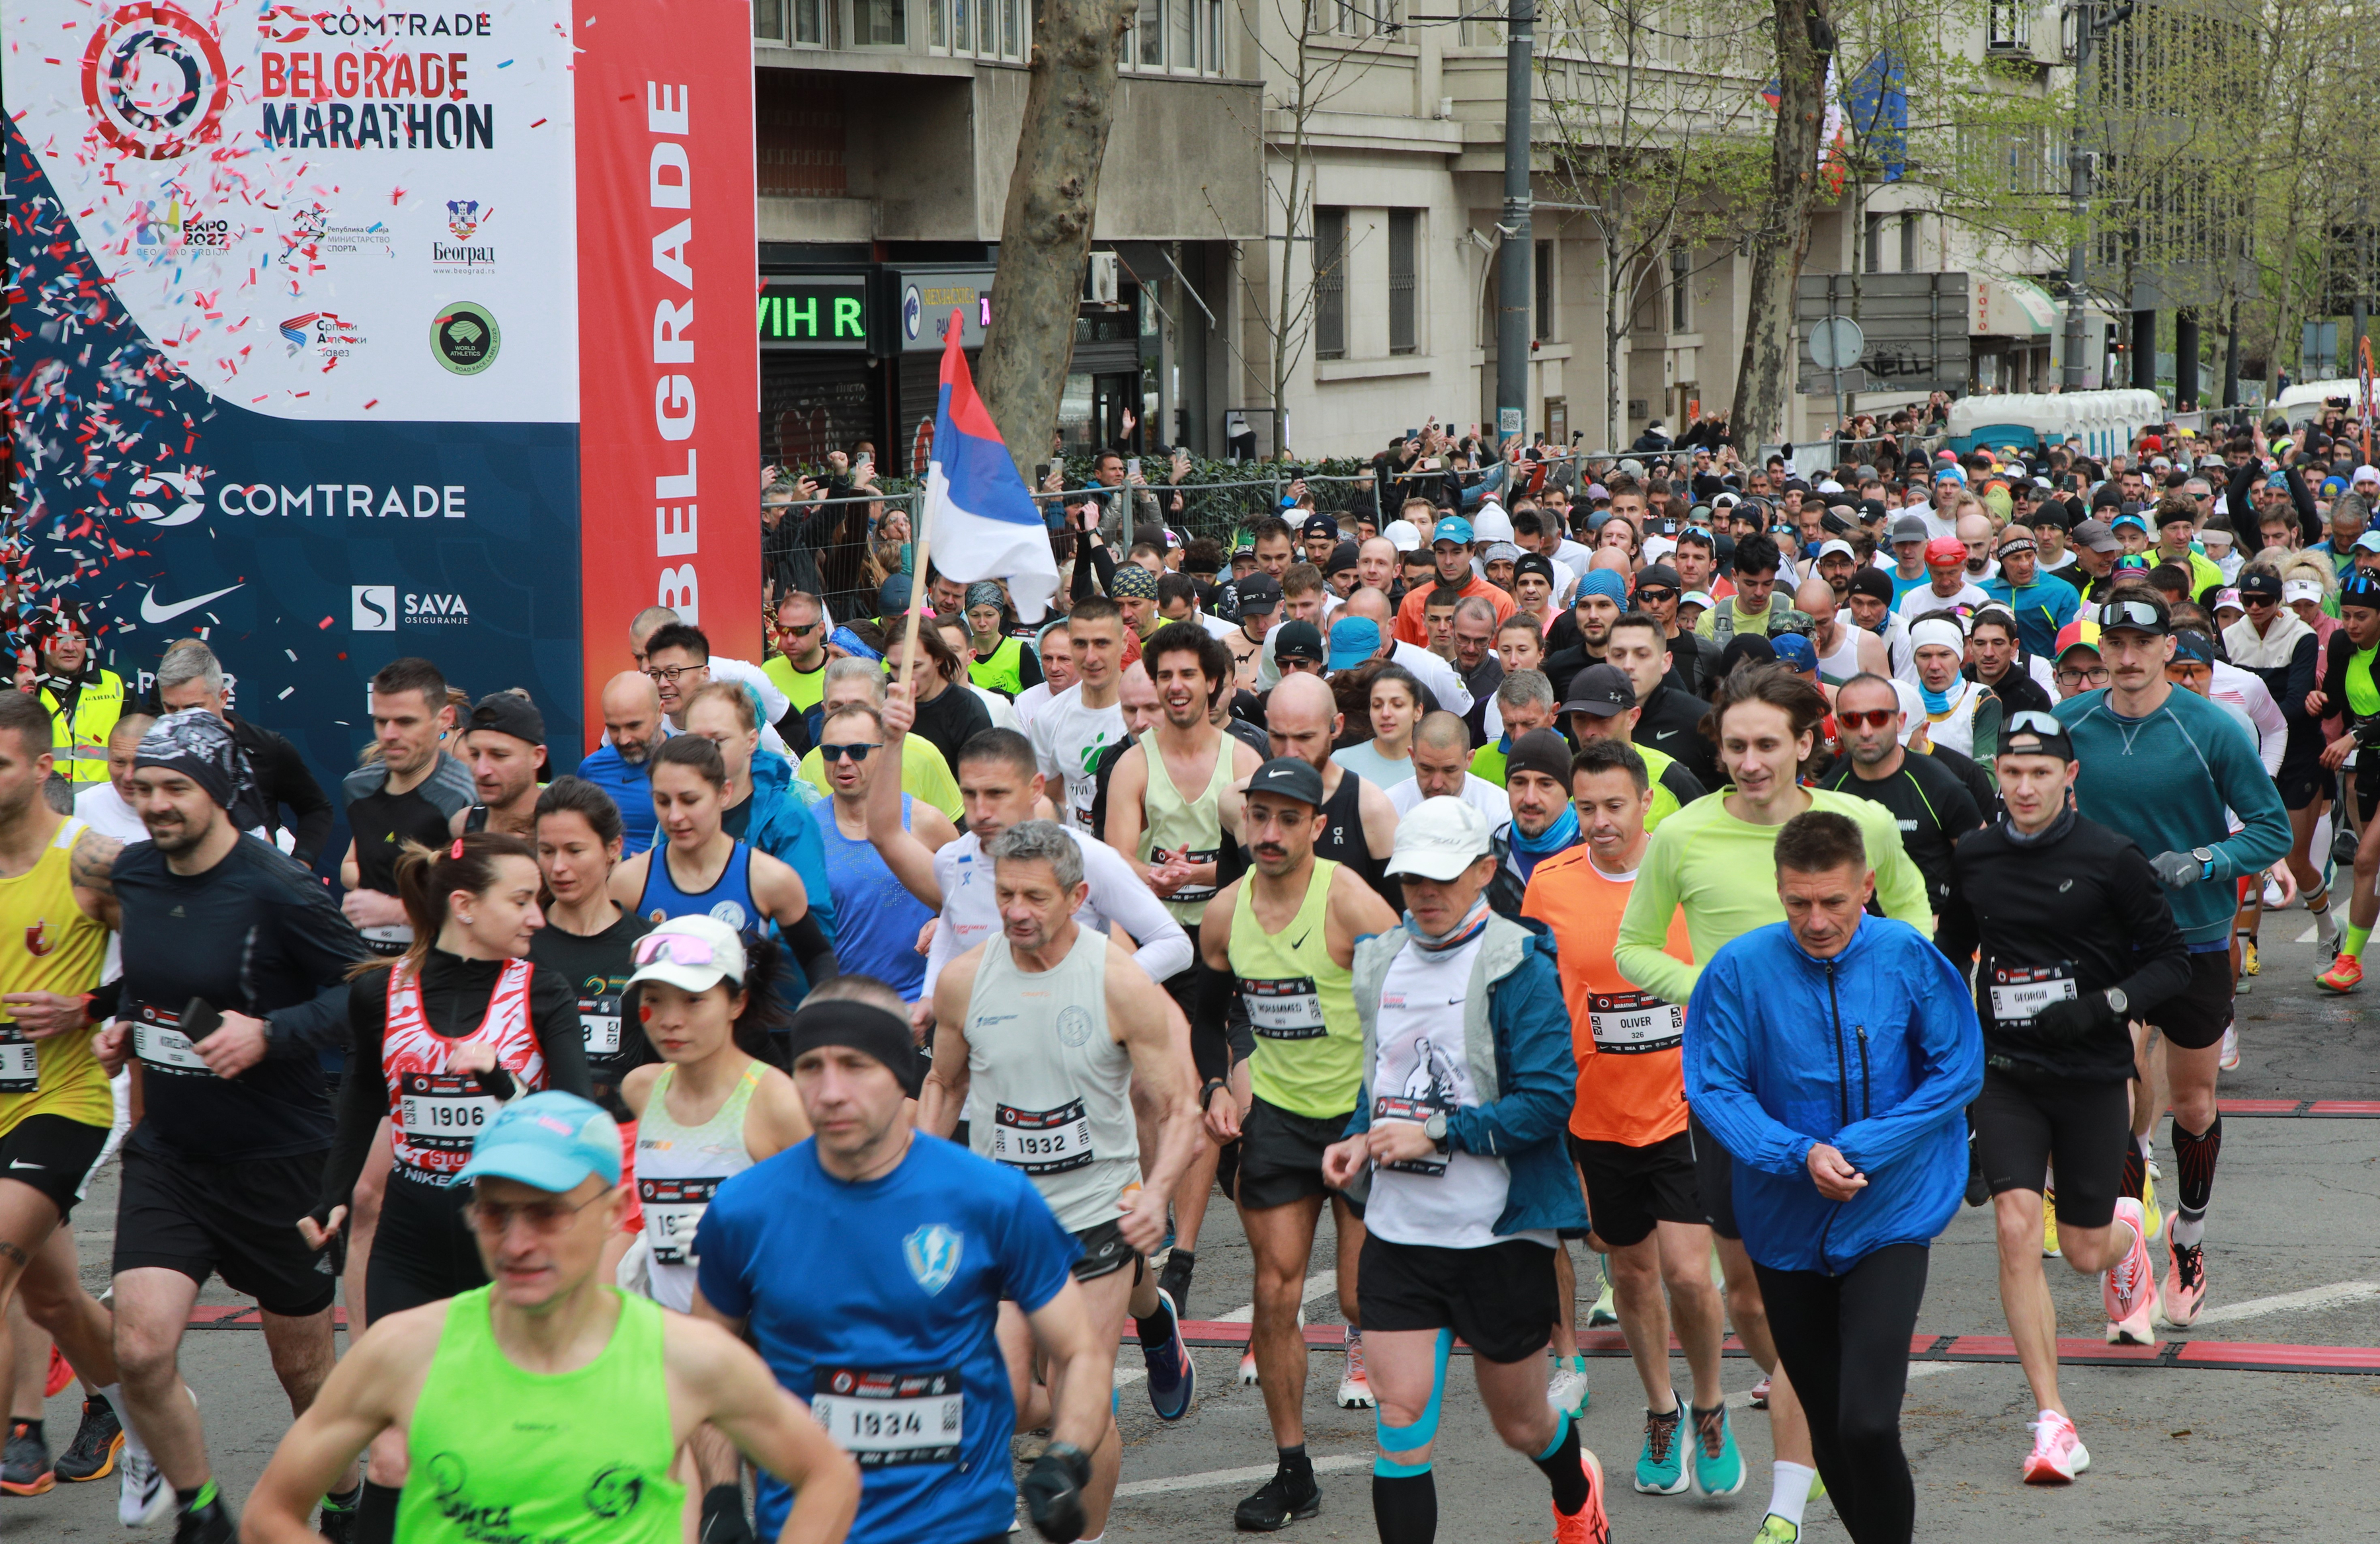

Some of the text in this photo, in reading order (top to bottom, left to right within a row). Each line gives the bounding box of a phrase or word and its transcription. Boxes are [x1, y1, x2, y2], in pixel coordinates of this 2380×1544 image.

[321, 13, 491, 36] COMTRADE
[261, 52, 468, 98] BELGRADE
[262, 102, 493, 149] MARATHON
[182, 220, 228, 232] EXPO
[182, 233, 228, 246] 2027
[432, 242, 495, 266] Београд
[924, 282, 975, 305] MENJAČNICA
[1978, 284, 1987, 331] FOTO
[317, 348, 350, 357] авез
[471, 361, 487, 371] RACE
[485, 345, 496, 362] LABEL
[647, 79, 699, 626] BELGRADE
[219, 483, 465, 518] COMTRADE
[404, 594, 469, 615] SAVA
[405, 616, 469, 625] OSIGURANJE
[1620, 1017, 1651, 1028] OLIVER
[430, 1106, 485, 1126] 1906
[1386, 1108, 1411, 1117] MARATHON
[1017, 1136, 1066, 1154] 1932
[405, 1167, 452, 1186] NIKE
[658, 1214, 690, 1236] 19
